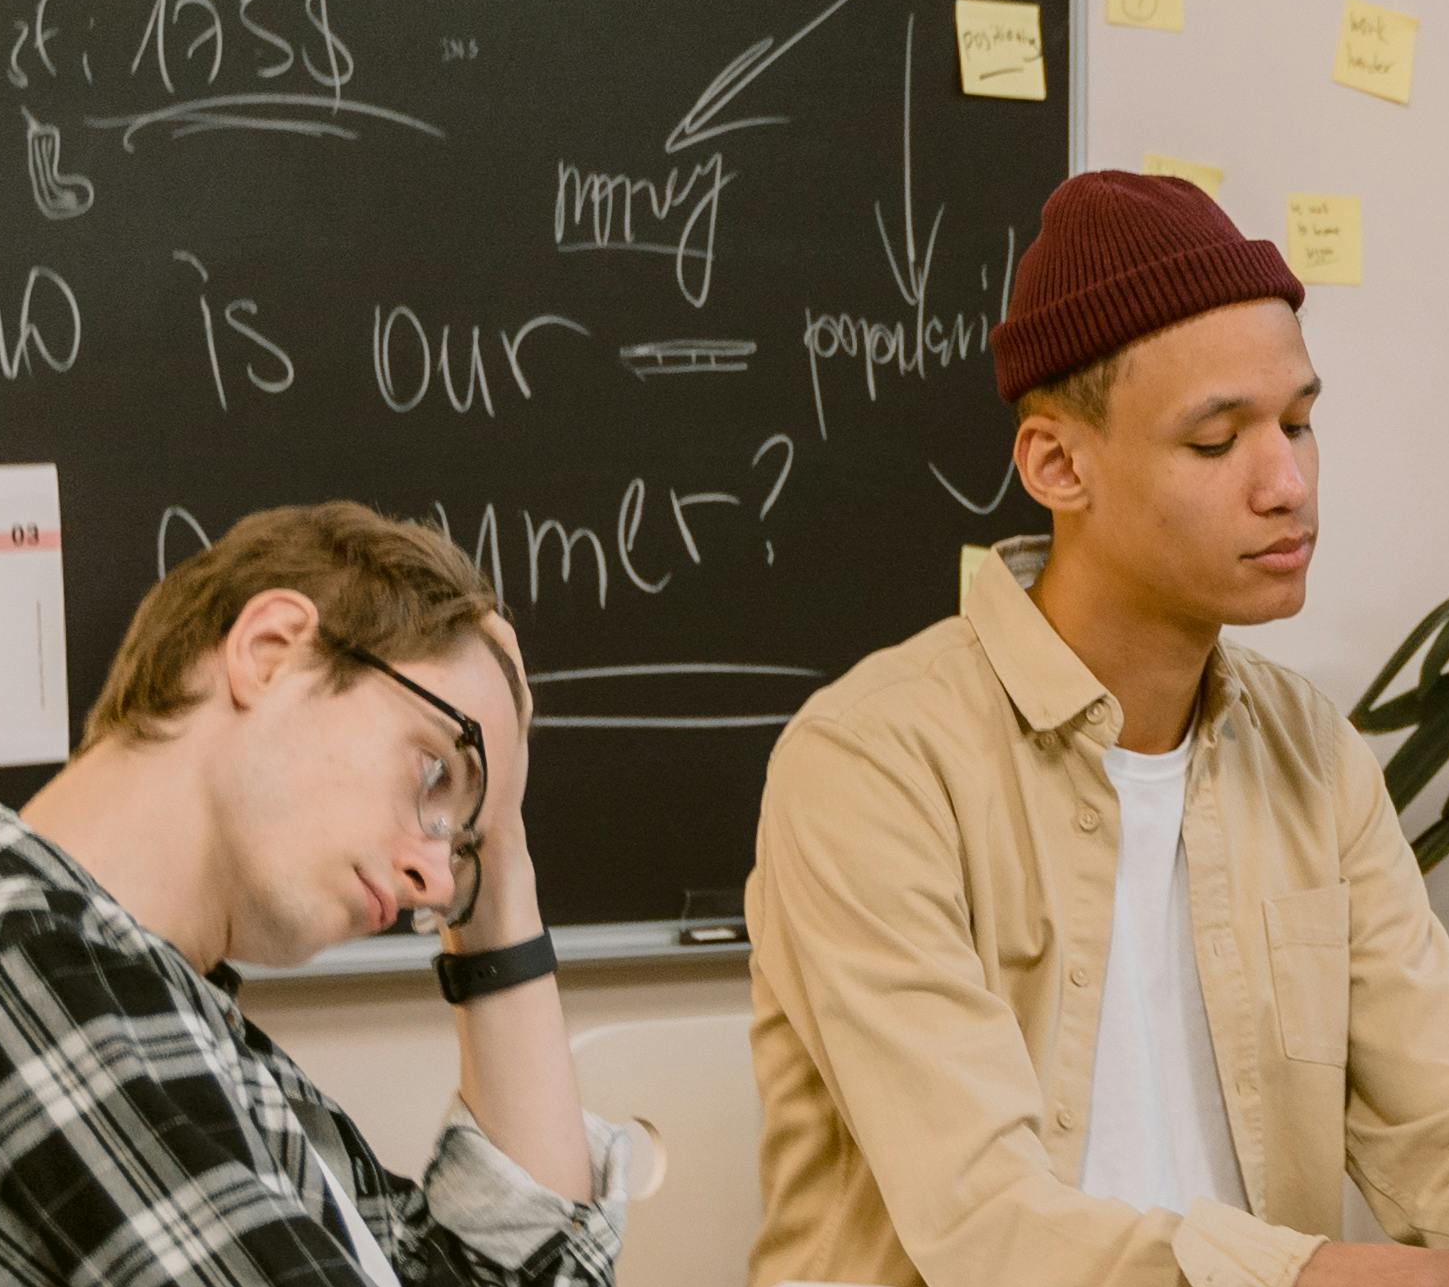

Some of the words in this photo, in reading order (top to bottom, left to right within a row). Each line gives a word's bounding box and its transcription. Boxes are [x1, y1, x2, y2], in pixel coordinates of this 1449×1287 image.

[173, 250, 296, 413] is
[374, 302, 591, 418] our
[10, 523, 41, 549] 03
